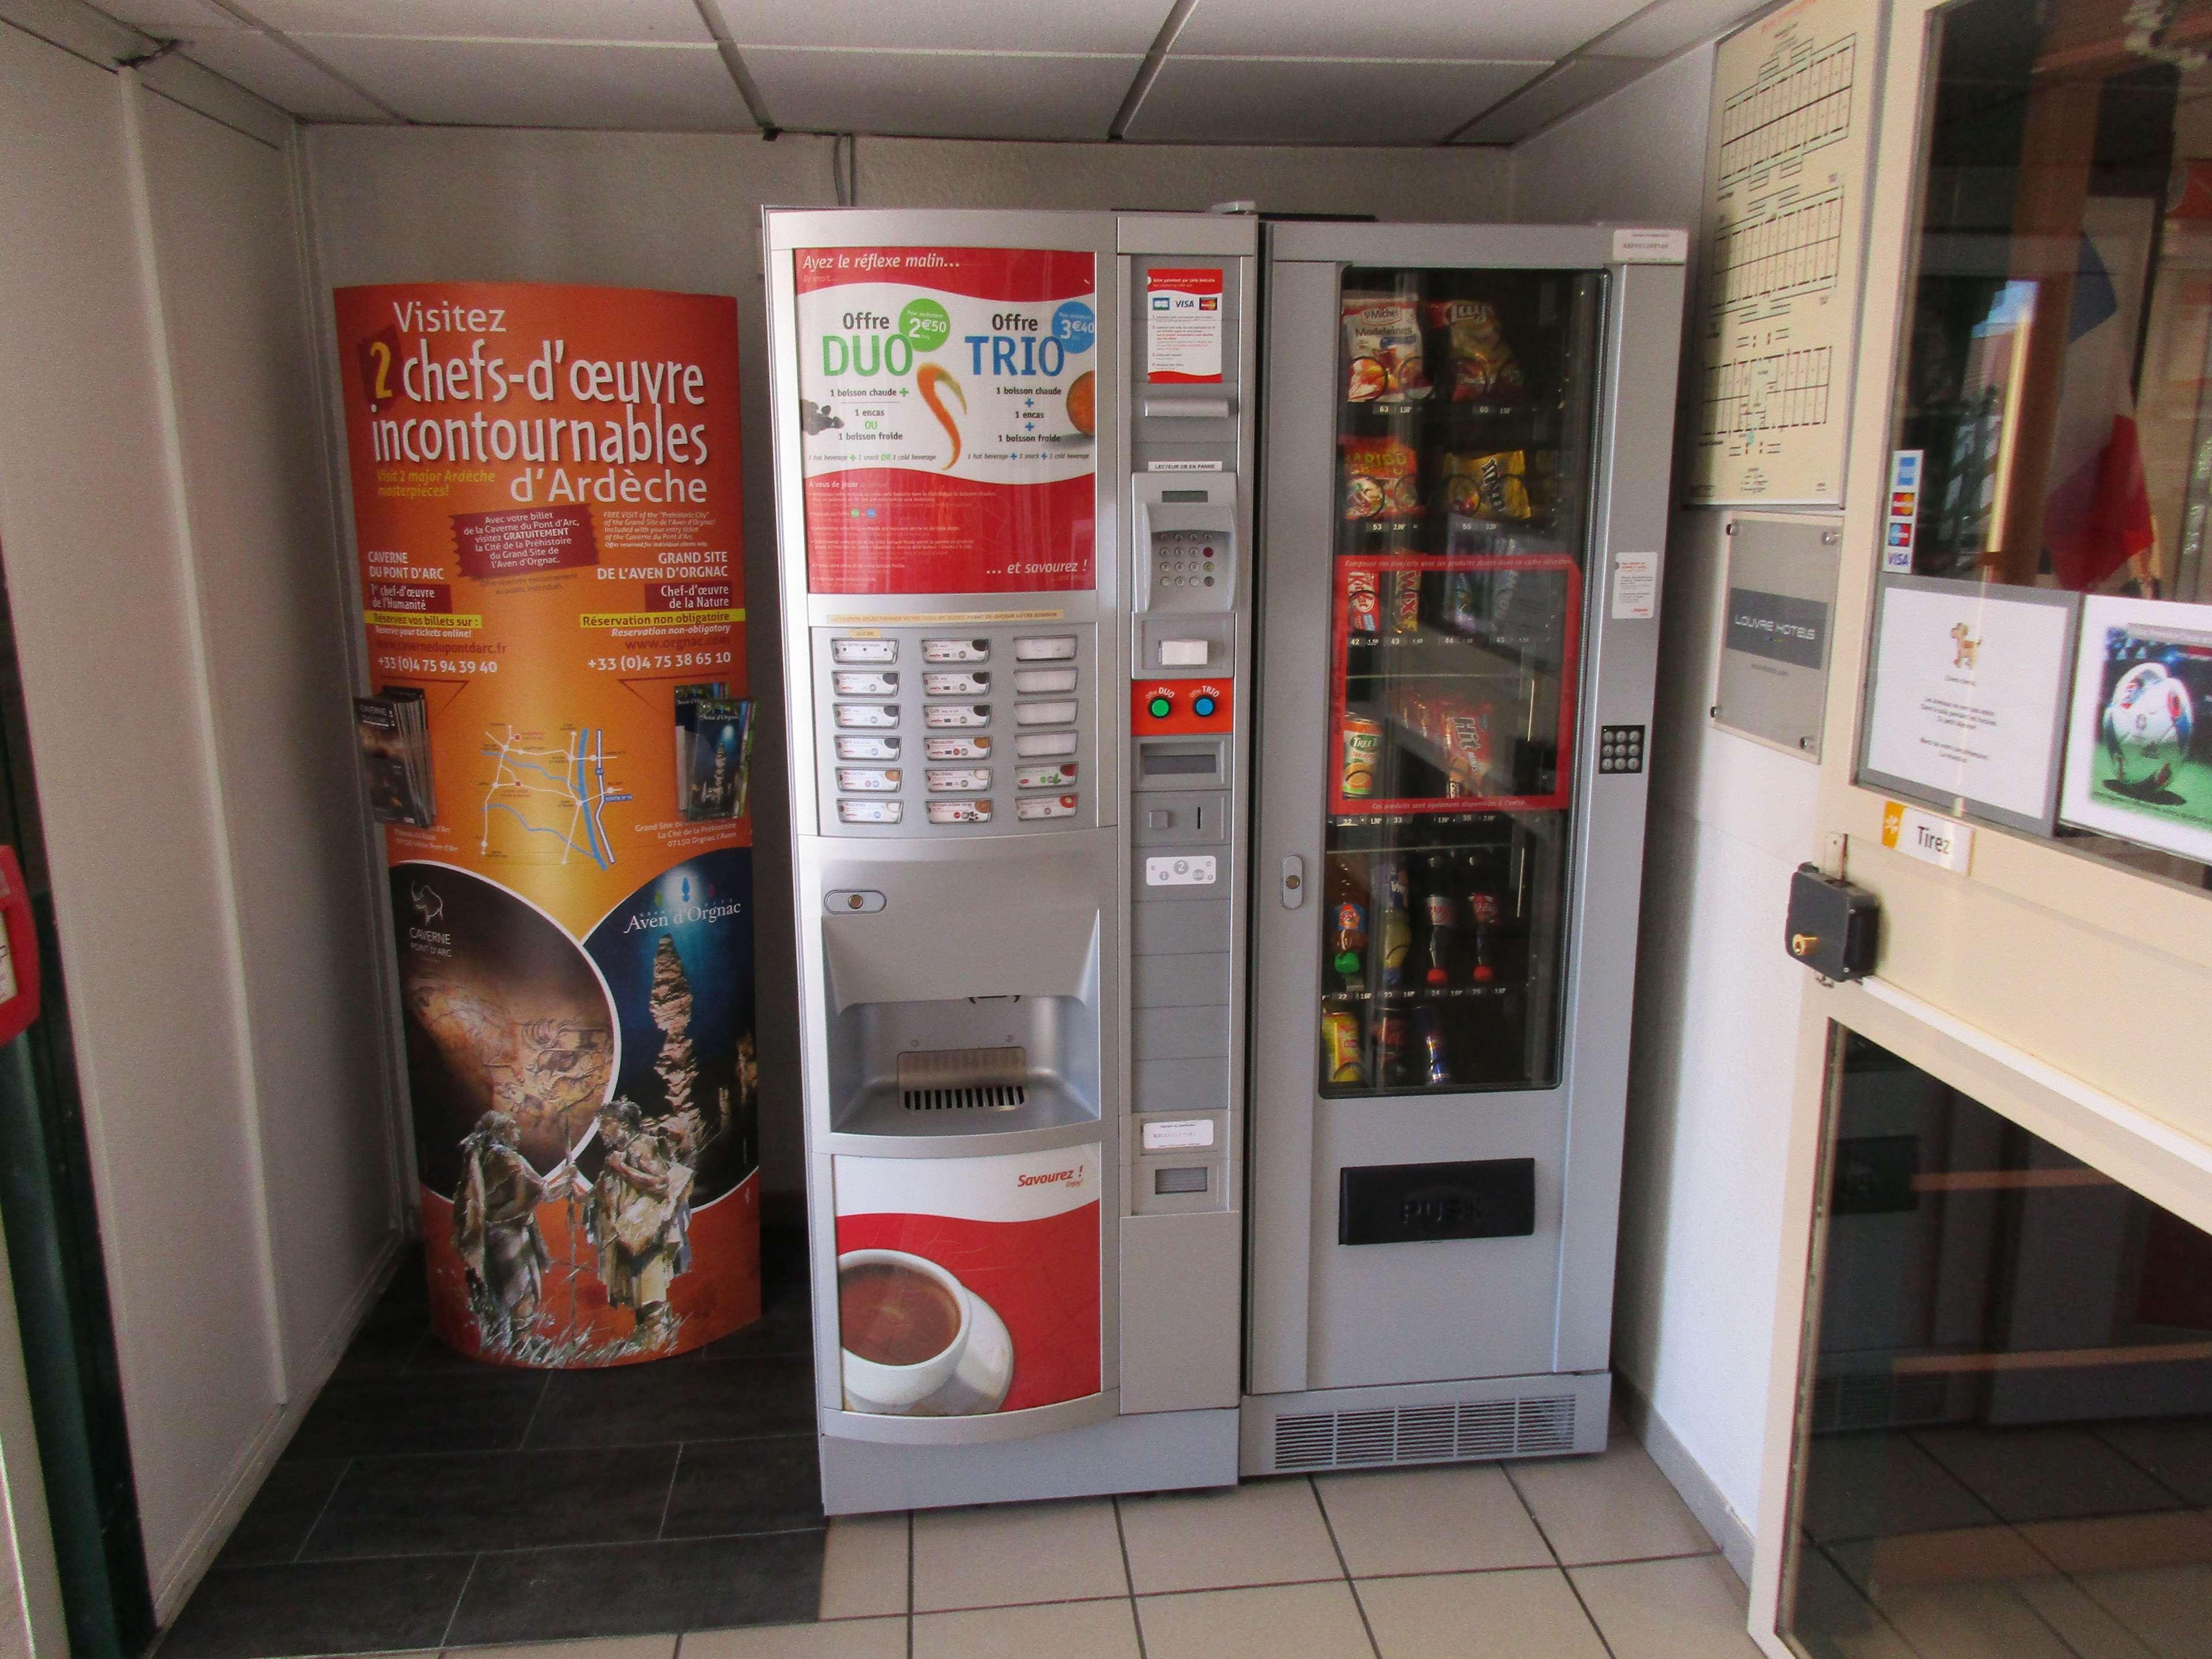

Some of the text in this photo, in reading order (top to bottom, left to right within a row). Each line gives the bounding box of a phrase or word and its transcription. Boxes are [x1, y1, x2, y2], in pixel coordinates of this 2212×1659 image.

[803, 253, 960, 271] Ayez le réflexe malin...
[393, 301, 506, 332] Visitez
[843, 312, 890, 330] Offre
[992, 314, 1038, 331] Offre
[908, 318, 947, 338] 2€50
[1060, 320, 1094, 339] 3€40
[1355, 327, 1413, 336] Madeleines
[823, 334, 913, 377] DUO
[964, 335, 1065, 377] TRIO
[370, 339, 706, 404] 2 chefs-d'œuvre
[837, 388, 867, 396] boisson
[869, 388, 896, 396] chaude
[1003, 387, 1033, 395] boisson
[1035, 387, 1062, 395] chaude
[865, 421, 877, 429] OU
[371, 404, 709, 465] incontournables
[845, 432, 876, 441] boisson
[878, 431, 903, 441] froide
[1005, 434, 1036, 443] boisson
[1038, 434, 1060, 443] froide
[409, 469, 441, 486] major
[512, 467, 707, 502] d'Ardèche
[841, 480, 858, 490] jouer
[485, 512, 554, 524] Avec votre billet
[464, 527, 474, 535] de
[485, 524, 518, 533] Caverne
[533, 521, 554, 529] Pont
[475, 528, 569, 543] visitez GRATUITEMENT
[484, 542, 501, 551] Cité
[516, 540, 524, 548] la
[525, 537, 572, 548] Préhistoire
[368, 551, 408, 564] CAVERNE
[490, 547, 559, 560] du Grand Site de
[658, 551, 728, 564] GRAND SITE
[1888, 553, 1909, 566] VISA
[492, 556, 560, 569] l'Aven d'Orgnac.
[1007, 562, 1079, 574] et savourez
[369, 567, 444, 580] DU PONT D'ARC
[597, 566, 728, 580] DE L'AVEN D'ORGNAC
[380, 584, 435, 599] chef-d'œuvre
[661, 585, 729, 597] Chef-d'œuvre
[372, 598, 427, 611] de l'Humanité
[669, 597, 729, 609] de la Nature
[374, 612, 472, 627] Réservez vos billets sur
[583, 612, 729, 626] Réservation non obligatoire
[375, 626, 471, 638] Reserve your tickets online!
[611, 624, 730, 637] Reservation non-obligatory
[1735, 614, 1816, 641] LOUVRE HOTELS
[626, 635, 730, 650] www.orgnac.com
[379, 656, 498, 673] +33 (0)4 75 94 39 40
[588, 652, 731, 672] +33 (0)4 75 38 65 10
[1158, 687, 1175, 699] DUO
[1202, 685, 1219, 698] TRIO
[635, 823, 657, 832] Grand
[701, 823, 737, 833] Préhistoire
[667, 835, 715, 847] 07150 Orgnac
[1917, 825, 1950, 854] Tirez
[1179, 861, 1184, 871] 2
[624, 915, 669, 933] Aven
[410, 927, 451, 945] CAVERNE
[1018, 1169, 1074, 1187] Savourez
